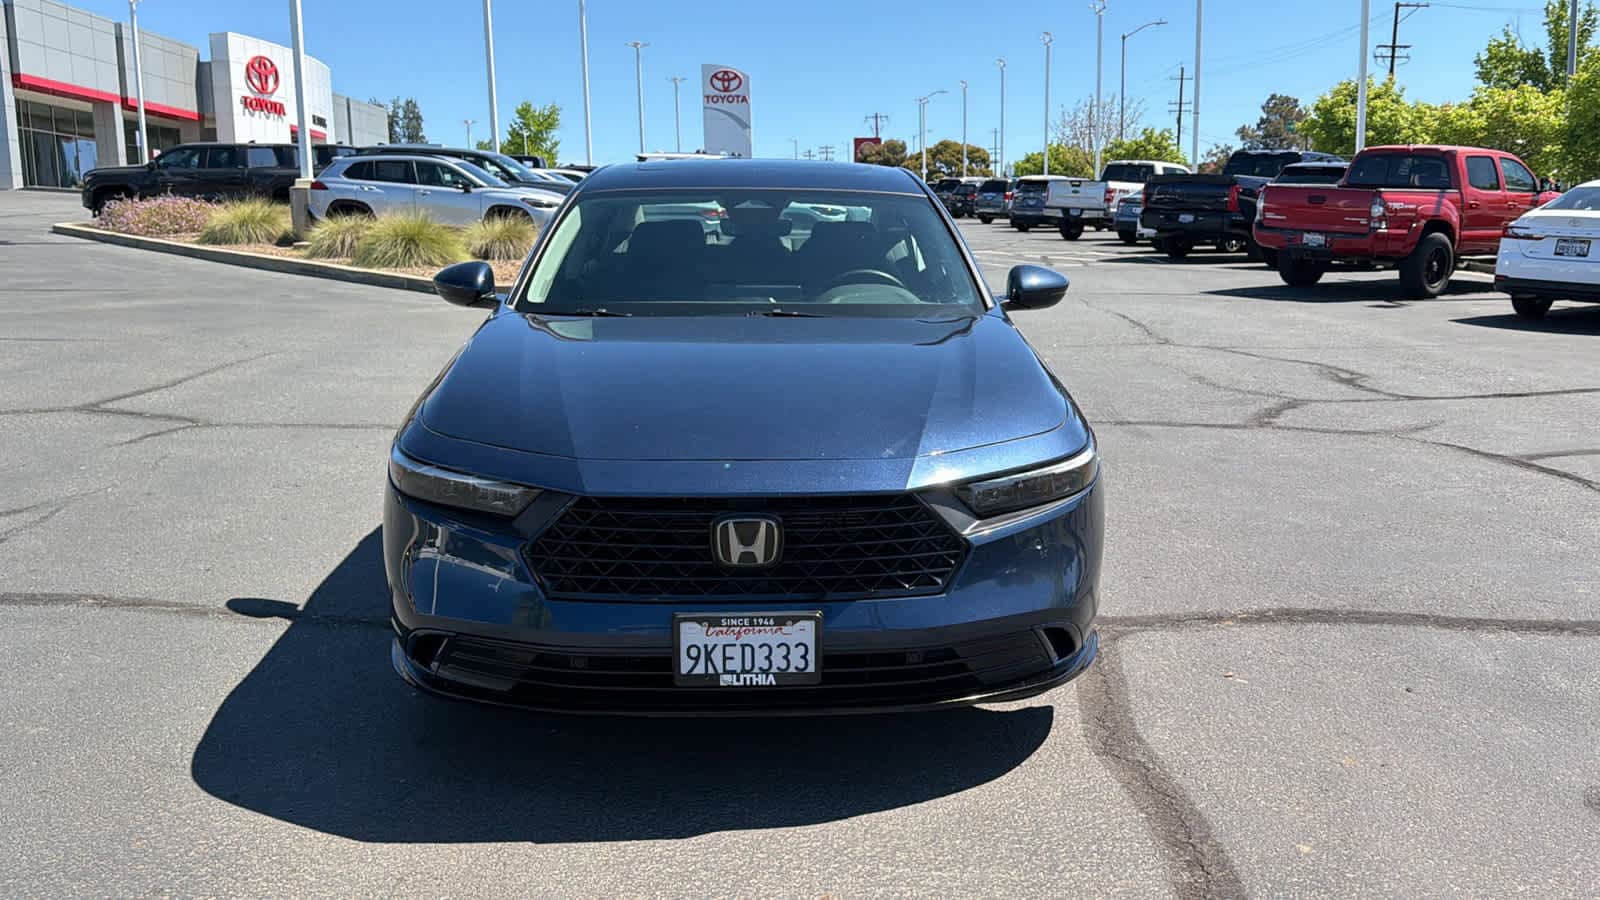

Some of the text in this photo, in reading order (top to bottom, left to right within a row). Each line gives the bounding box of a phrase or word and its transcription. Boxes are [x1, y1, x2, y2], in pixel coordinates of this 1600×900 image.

[241, 95, 286, 116] TOYOTA
[704, 95, 749, 104] TOYOTA
[721, 618, 775, 626] SINCE 1946
[702, 622, 793, 641] California
[686, 642, 809, 675] 9KED333
[732, 673, 776, 686] LITHIA
